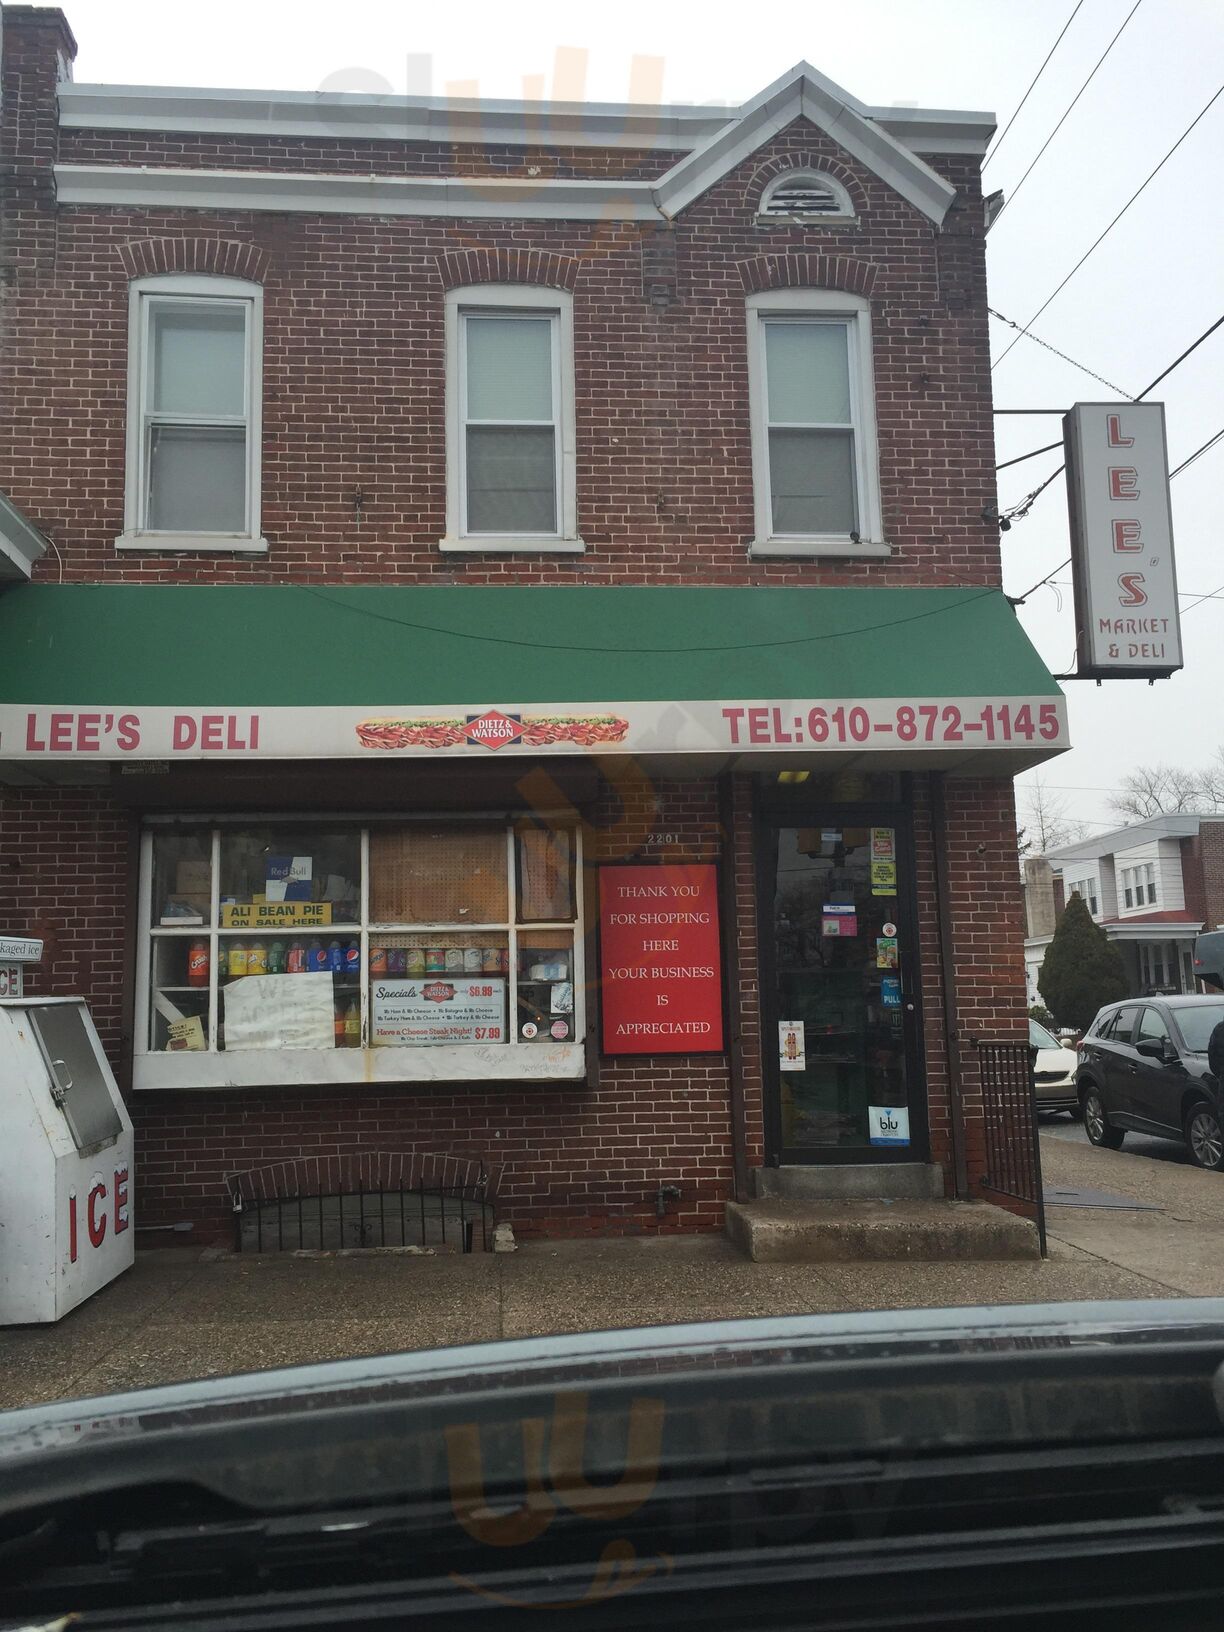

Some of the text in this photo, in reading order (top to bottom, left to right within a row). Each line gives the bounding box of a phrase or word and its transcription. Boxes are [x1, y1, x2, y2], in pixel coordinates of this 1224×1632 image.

[1099, 618, 1169, 636] MARKET
[1108, 643, 1165, 658] & DELI
[479, 720, 512, 729] DIETZ &
[26, 713, 259, 751] LEE'S DELI
[472, 728, 514, 738] WATSON
[648, 834, 679, 844] 2201
[270, 866, 307, 877] Red Bull
[618, 886, 700, 898] THANK YOU
[230, 905, 324, 917] ALI BEAN PIE
[231, 919, 249, 927] ON
[292, 918, 324, 926] HERE
[610, 912, 710, 925] FOR SHOPPING
[28, 944, 40, 955] ice
[643, 940, 679, 951] HERE
[609, 967, 714, 979] YOUR BUSINESS
[376, 986, 417, 1001] Specials
[884, 995, 901, 1004] PULL
[657, 995, 669, 1006] IS
[450, 1027, 472, 1036] Night!
[616, 1022, 711, 1035] APPRECIATED
[879, 1116, 899, 1130] blu
[68, 1160, 130, 1264] ICE
